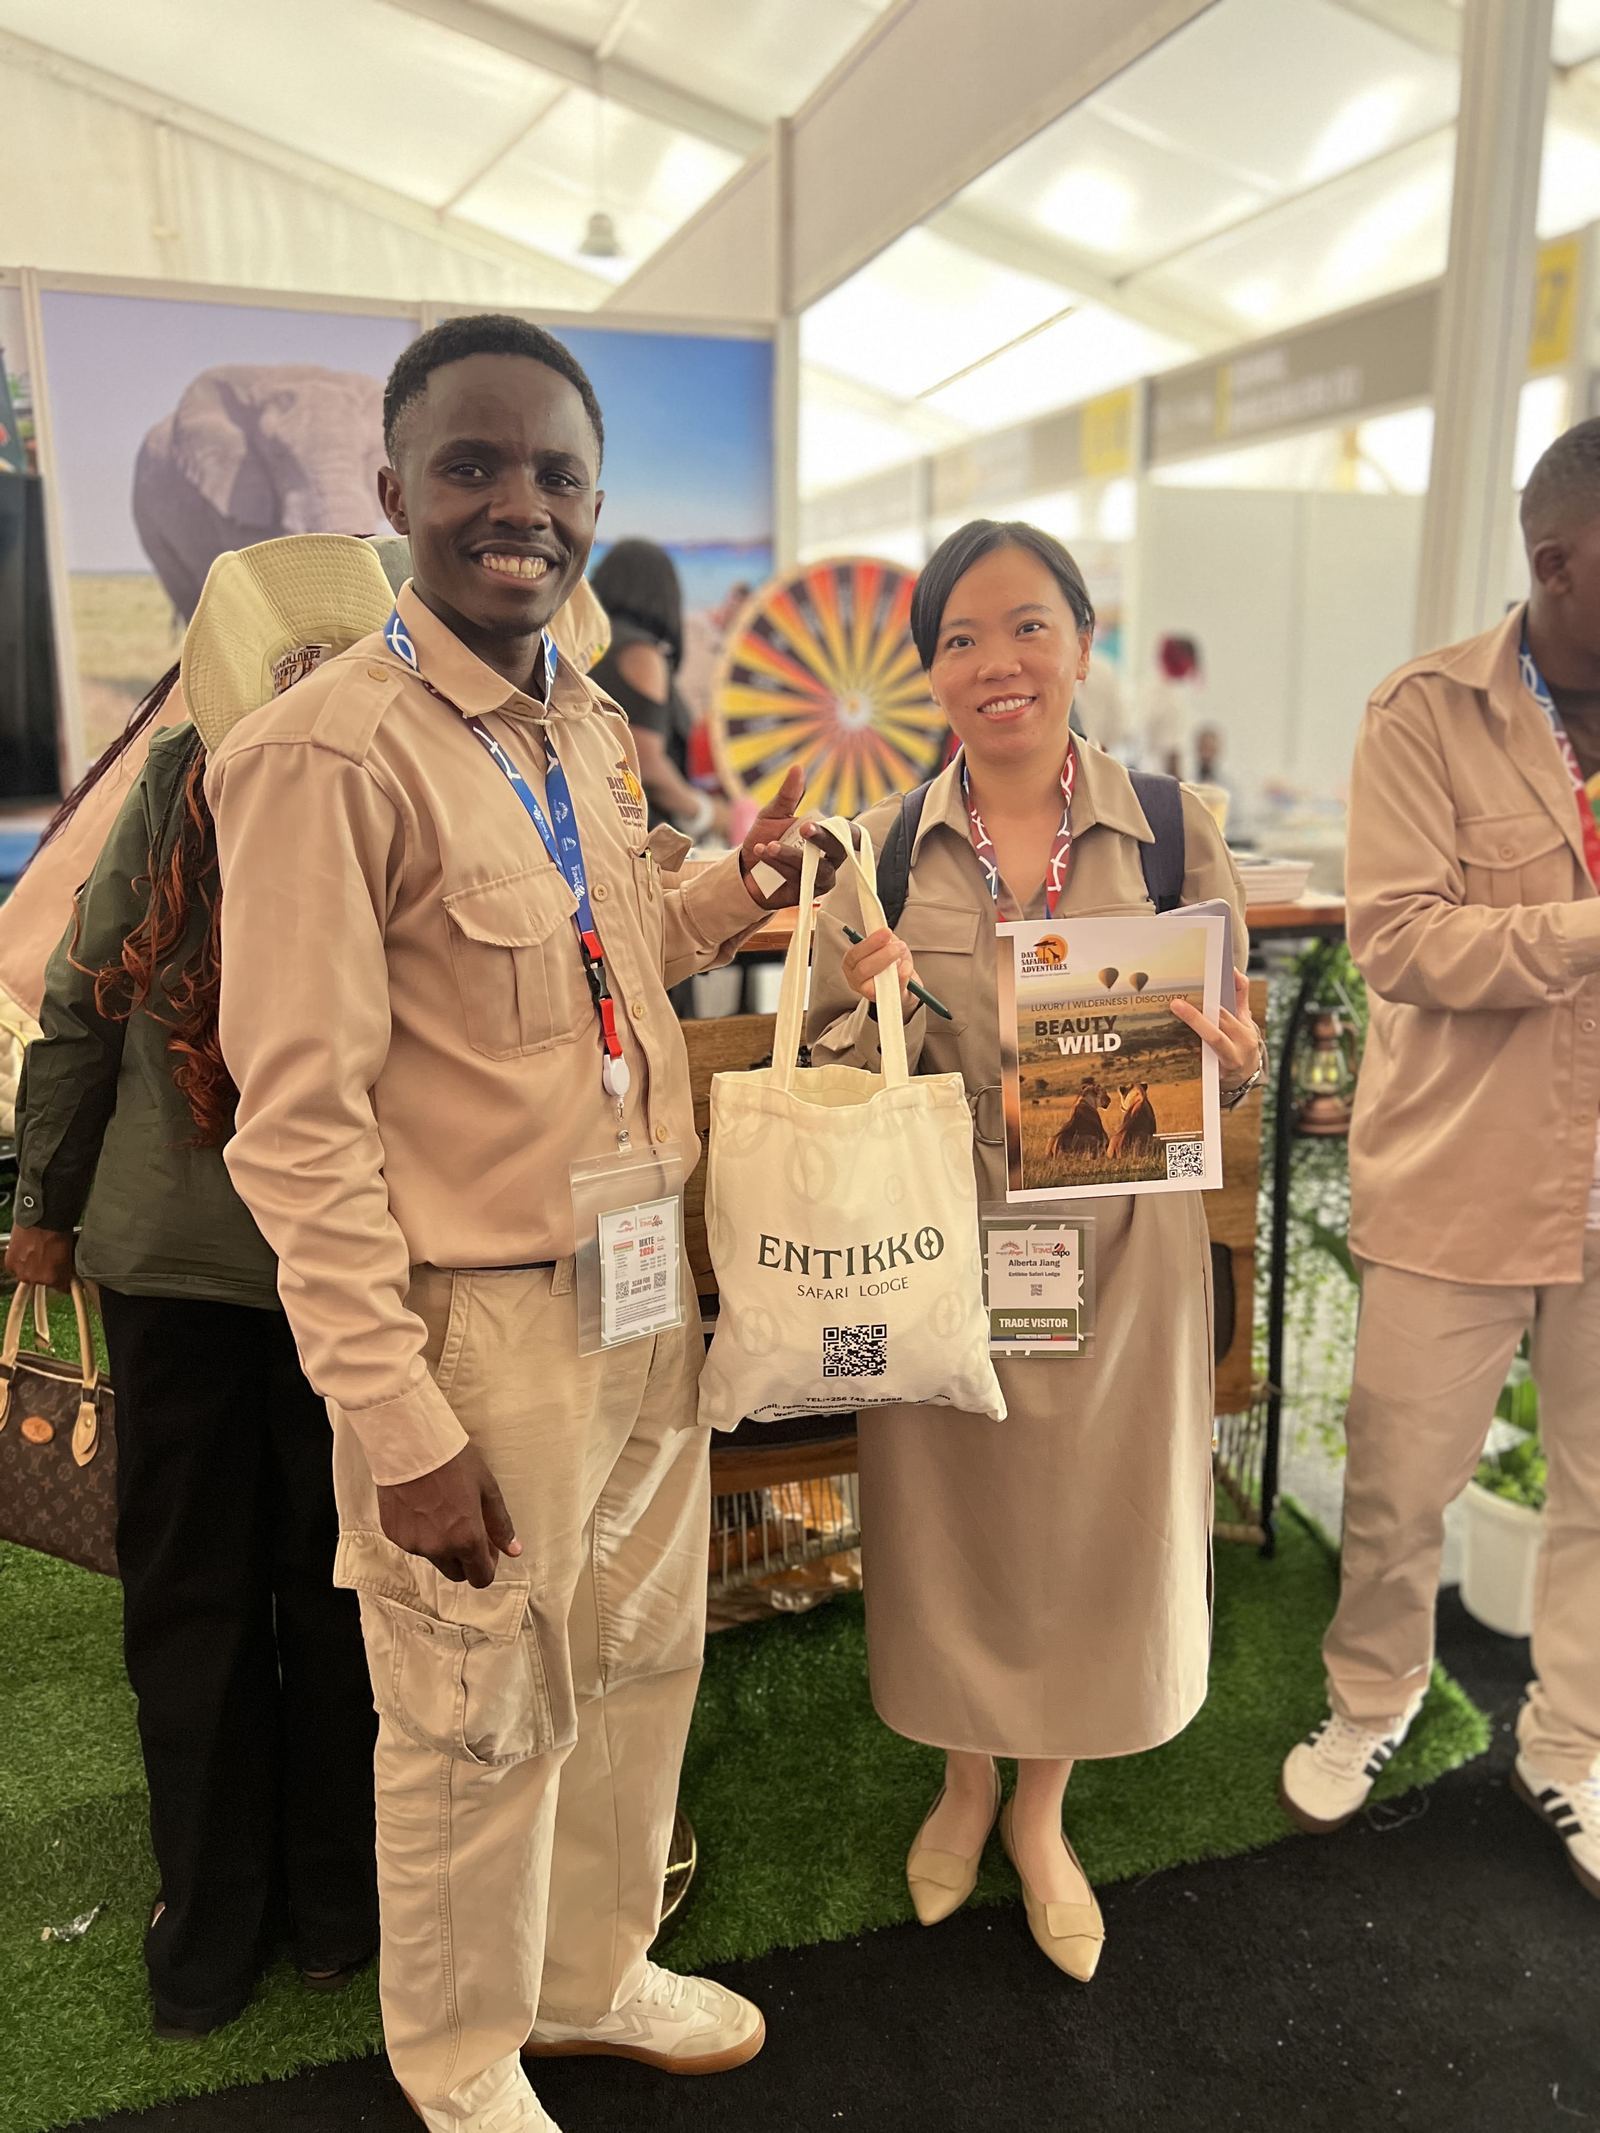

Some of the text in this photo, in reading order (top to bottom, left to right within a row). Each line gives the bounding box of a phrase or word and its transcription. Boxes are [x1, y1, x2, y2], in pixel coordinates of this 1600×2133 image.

[1022, 963, 1067, 973] ADVENTURES
[1031, 1002, 1065, 1012] LUXURY
[1073, 997, 1128, 1009] WILDERNESS
[1034, 1014, 1118, 1036] BEAUTY
[1057, 1033, 1122, 1055] WILD
[757, 1226, 945, 1279] ENTIKKO
[1008, 1259, 1060, 1268] Alberta Jiang
[797, 1276, 909, 1300] SAFARI LODGE
[999, 1318, 1068, 1328] TRADE VISITOR
